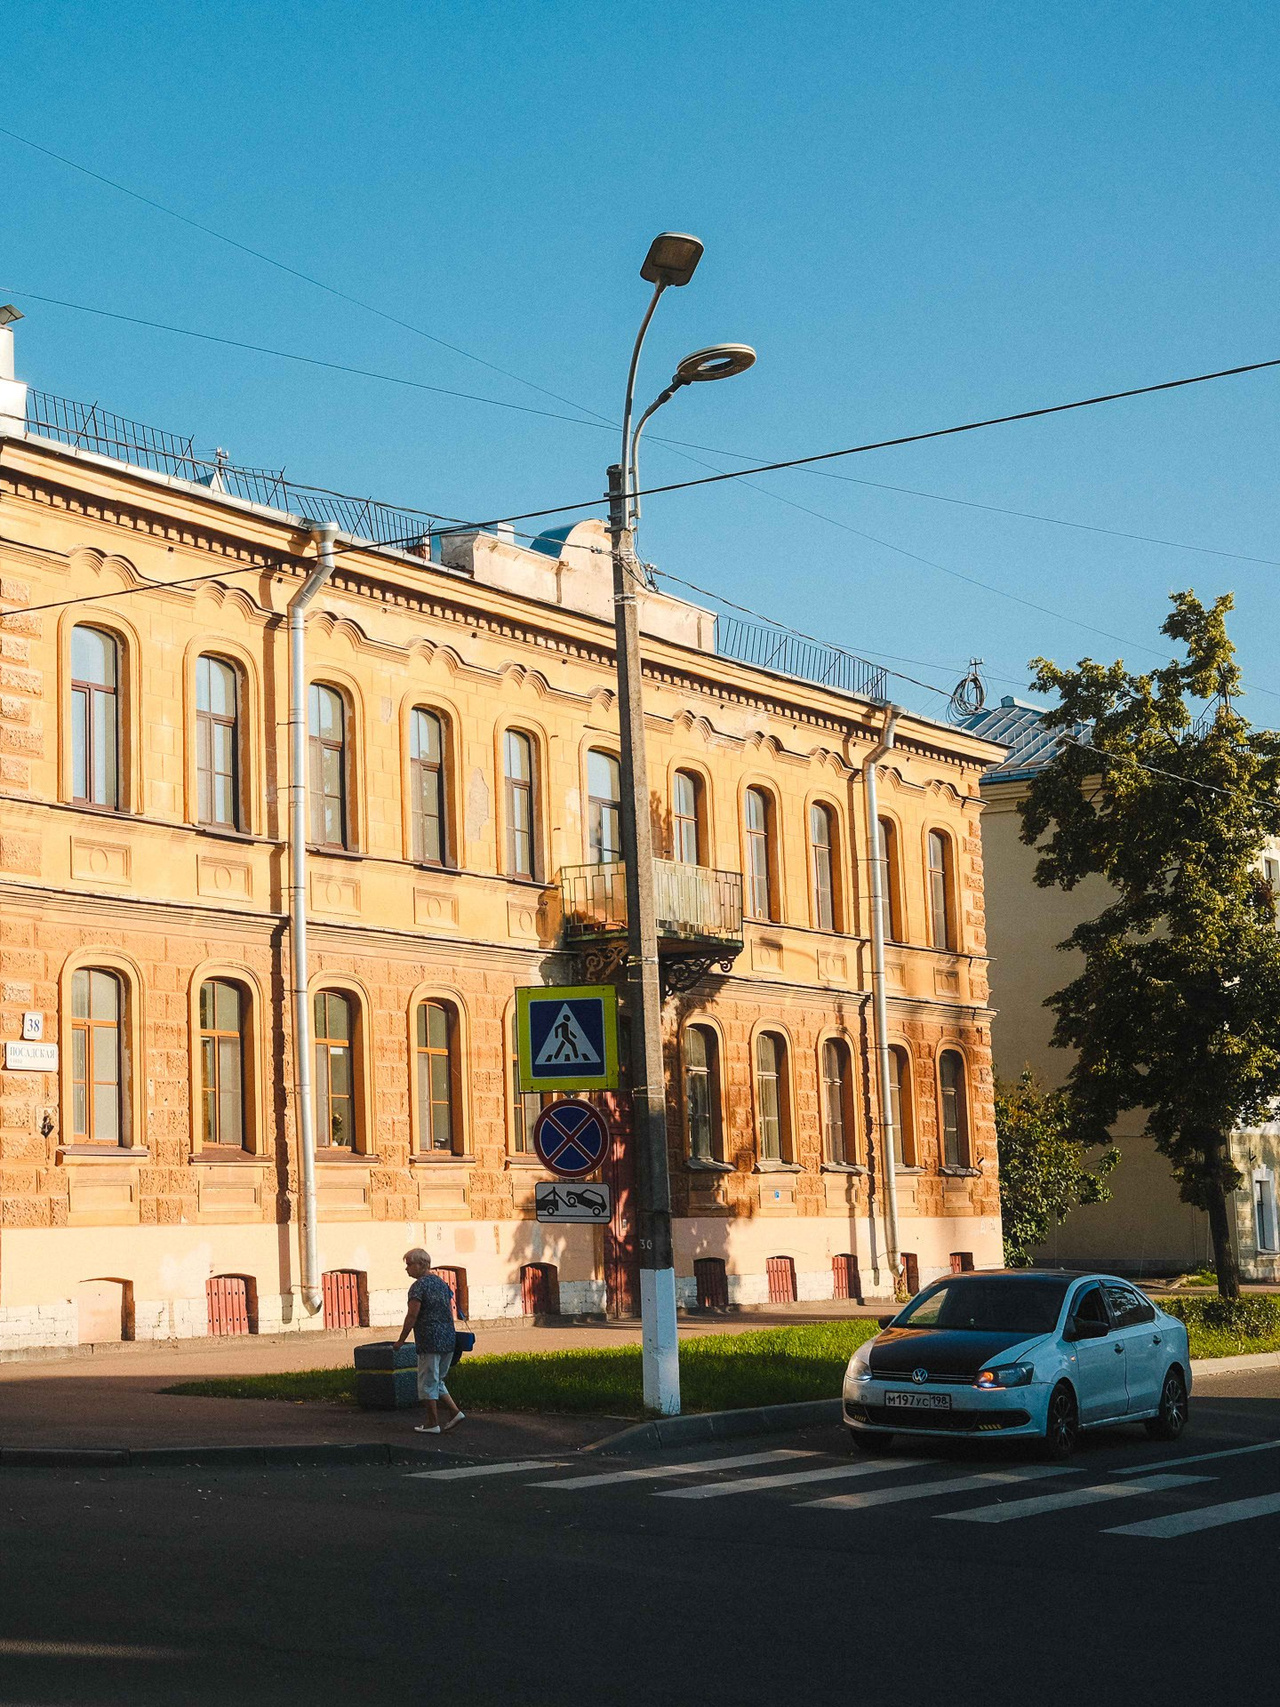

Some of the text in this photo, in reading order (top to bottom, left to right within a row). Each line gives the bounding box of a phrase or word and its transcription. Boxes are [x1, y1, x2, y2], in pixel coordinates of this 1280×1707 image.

[26, 1018, 40, 1032] 38
[9, 1046, 55, 1059] ПОСАДСКАЯ
[639, 1239, 653, 1250] 30
